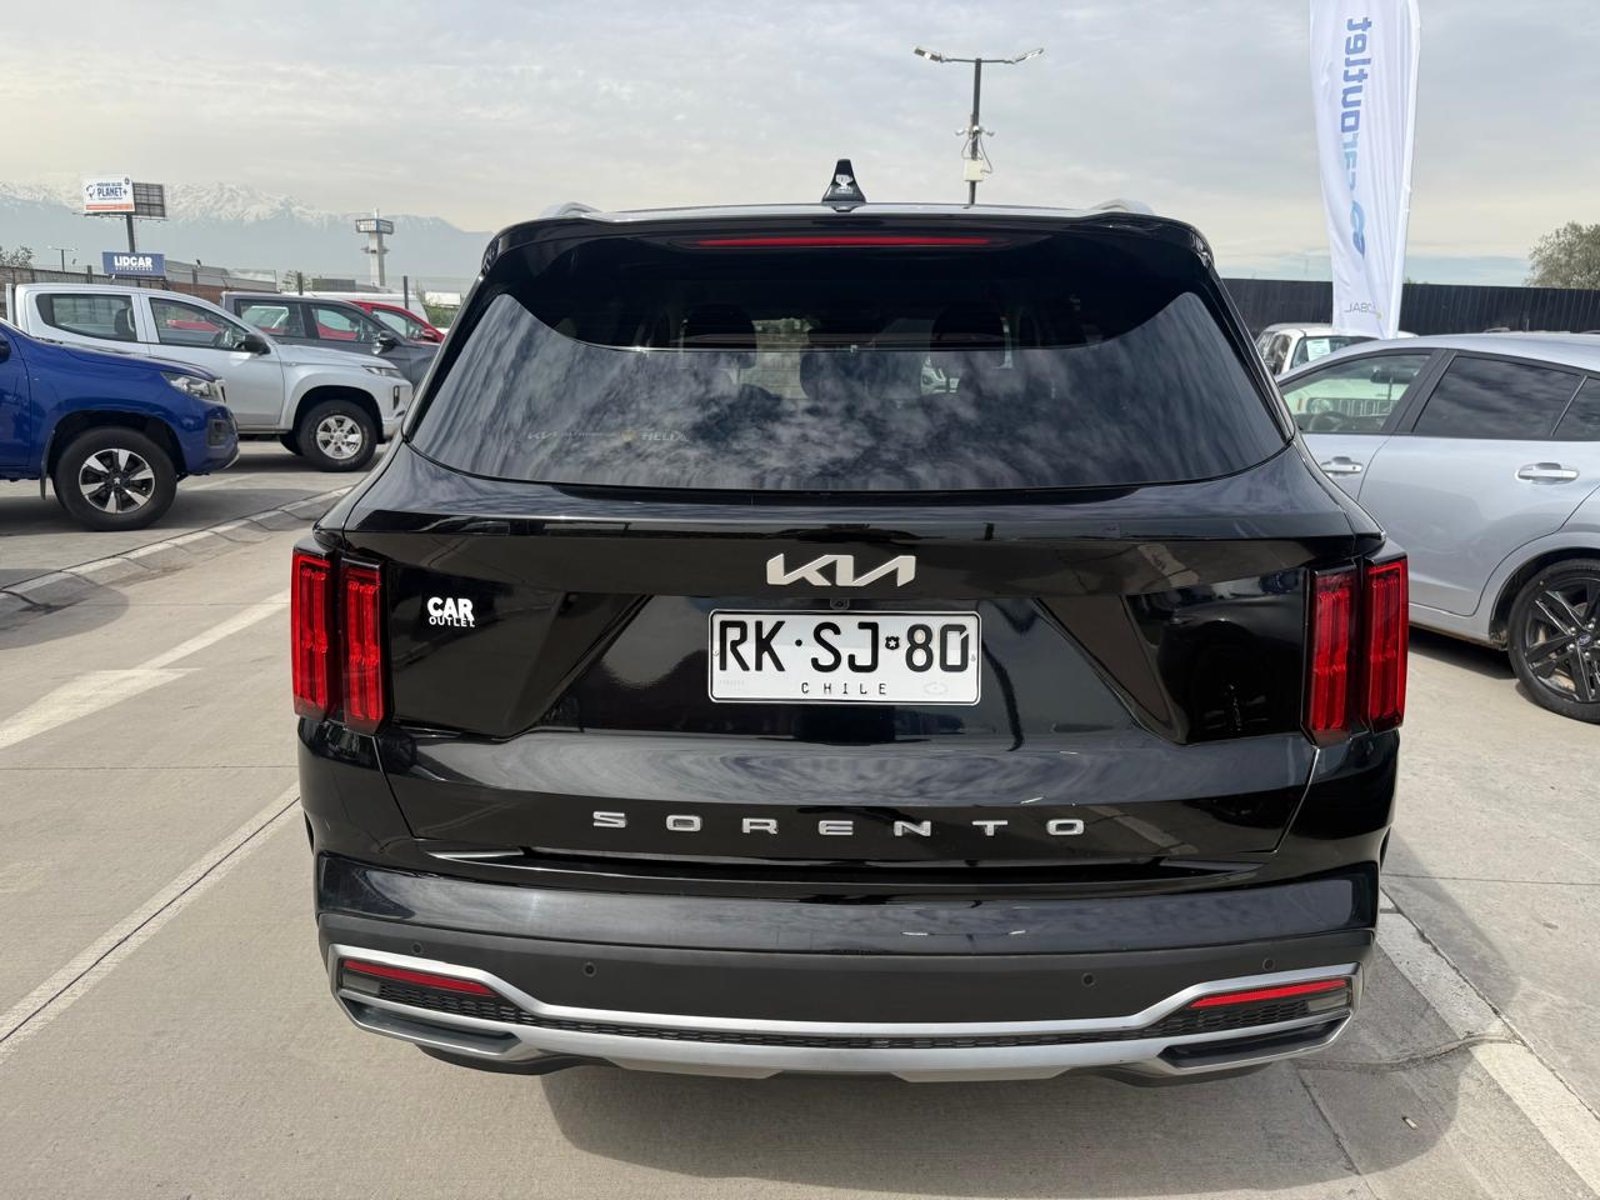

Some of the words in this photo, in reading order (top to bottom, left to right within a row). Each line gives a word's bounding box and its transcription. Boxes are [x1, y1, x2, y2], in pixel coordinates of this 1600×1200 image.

[114, 255, 152, 267] LIDCAR
[766, 553, 916, 587] KIA
[427, 596, 475, 621] CAR
[428, 616, 476, 628] OUTLET
[800, 682, 887, 696] CHILE
[593, 810, 1085, 837] SORENTO
